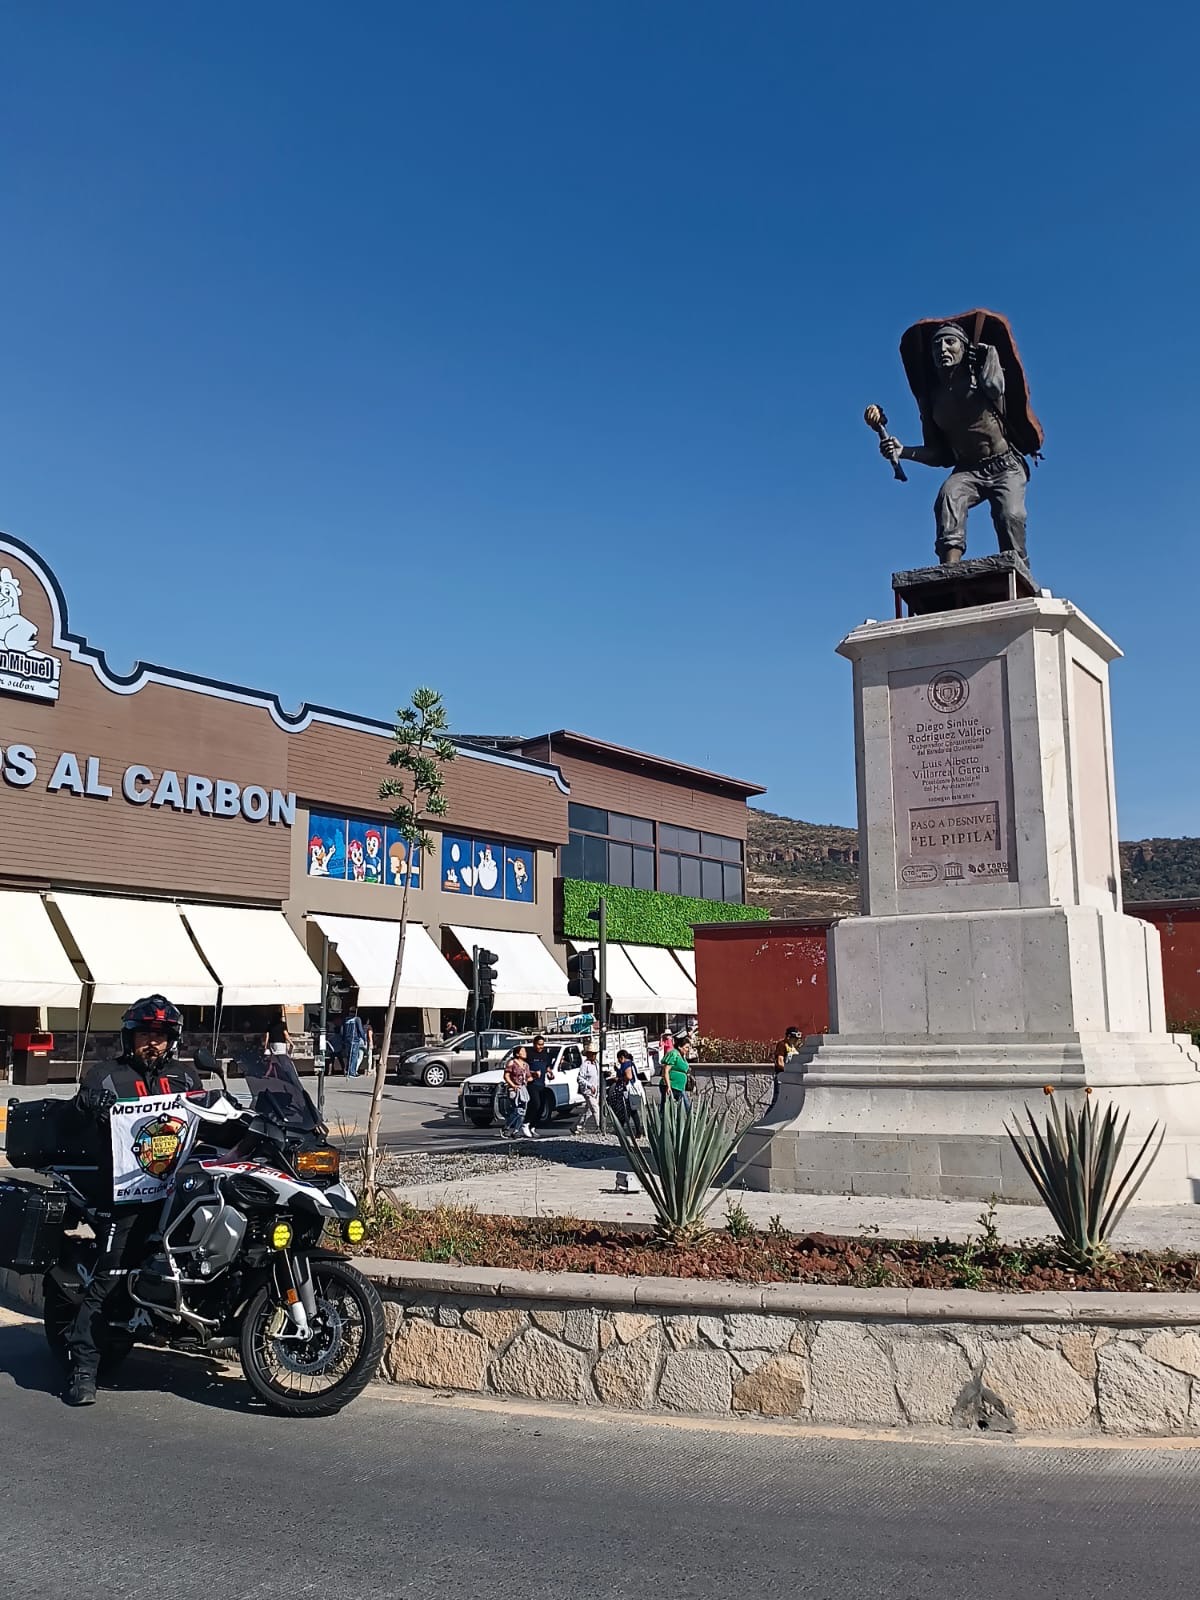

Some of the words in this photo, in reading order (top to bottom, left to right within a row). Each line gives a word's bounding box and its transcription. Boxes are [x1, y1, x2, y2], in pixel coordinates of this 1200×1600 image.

[10, 653, 50, 678] Miguel
[8, 679, 35, 691] sabor
[916, 722, 944, 733] Diego
[946, 717, 979, 729] Sinhue
[958, 726, 991, 738] Vallejo
[922, 760, 942, 769] Luis
[945, 756, 979, 766] Alberto
[912, 768, 955, 779] Villarreal
[0, 744, 37, 786] S
[47, 752, 113, 798] AL
[122, 764, 297, 826] CARBON
[911, 819, 936, 831] PASO
[938, 819, 946, 829] A
[948, 814, 996, 827] DESNIVEL
[112, 1101, 187, 1116] MOTOTUR
[117, 1188, 132, 1197] EN
